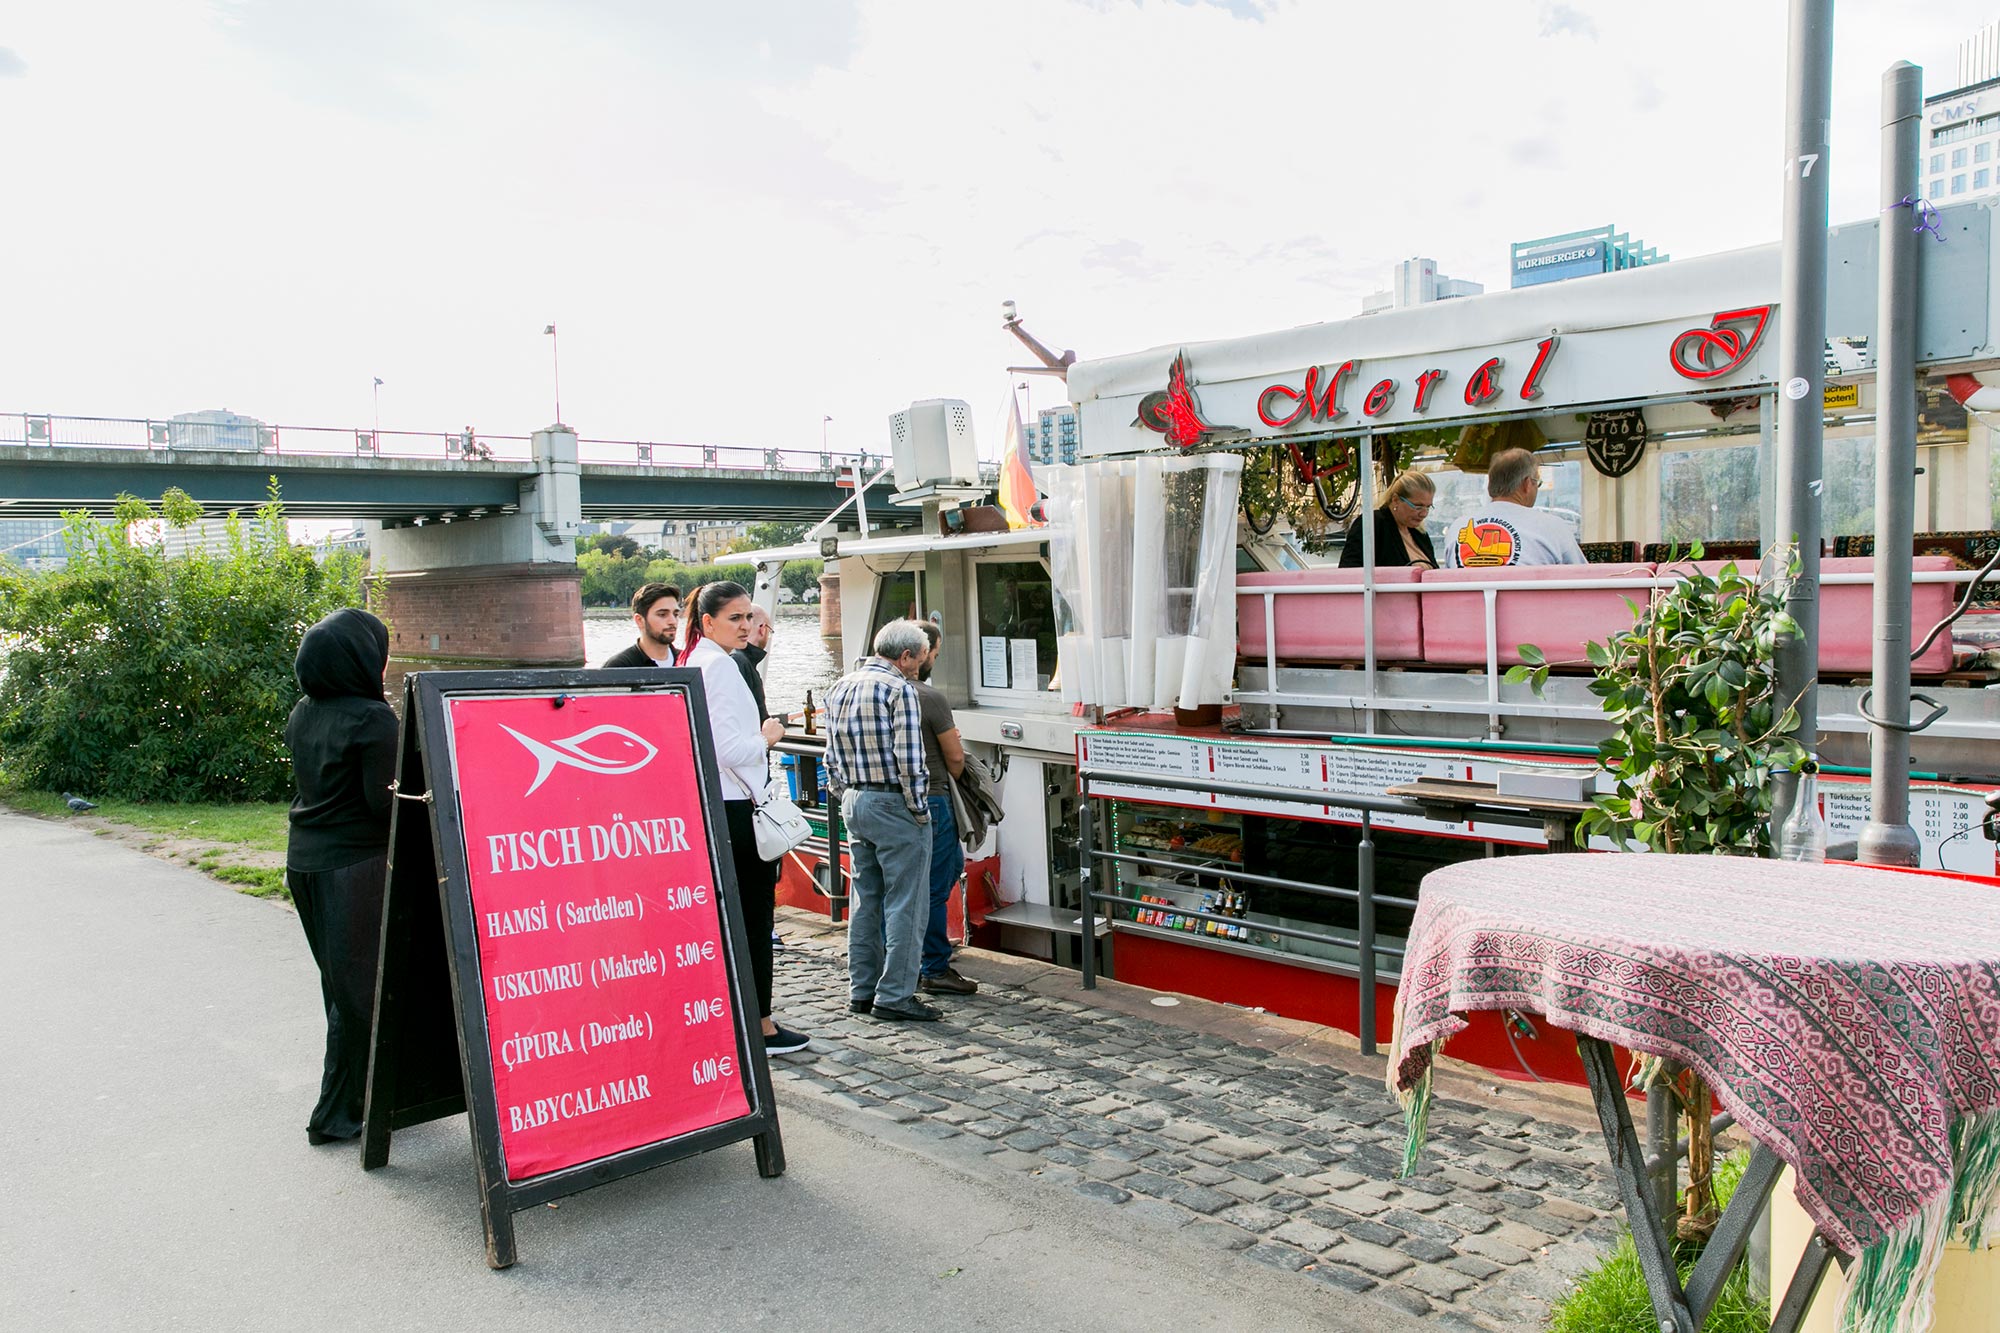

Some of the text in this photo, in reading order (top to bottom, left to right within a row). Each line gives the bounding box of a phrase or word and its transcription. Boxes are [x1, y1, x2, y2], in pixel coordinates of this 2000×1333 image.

[1257, 336, 1562, 428] Meral
[1830, 793, 1862, 802] Türkischer
[1830, 803, 1862, 812] Türkischer
[1830, 812, 1863, 822] Türkischer
[487, 813, 691, 874] FISCH DÖNER
[1830, 822, 1850, 830] Kaffee
[667, 885, 708, 911] 5.00€
[493, 962, 583, 1002] USKUMRU
[676, 940, 716, 968] 5.00€
[501, 1029, 573, 1072] ÇİPURA
[684, 998, 725, 1026] 5.00€
[509, 1056, 733, 1133] BABYCALAMAR 6.00€
